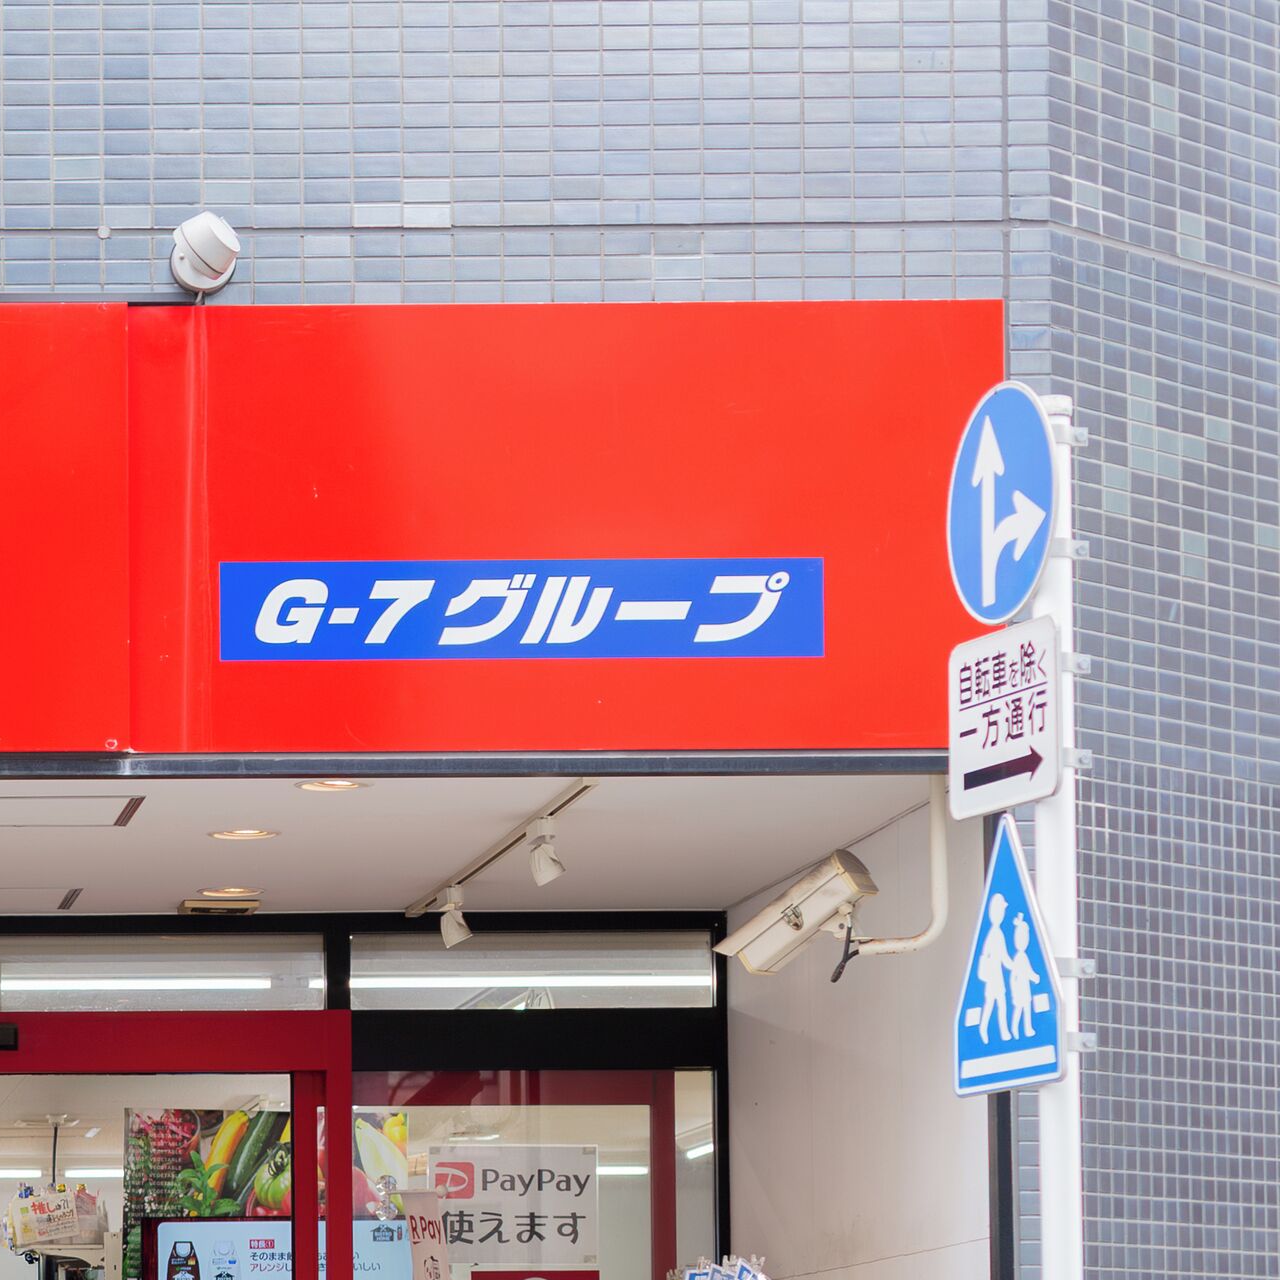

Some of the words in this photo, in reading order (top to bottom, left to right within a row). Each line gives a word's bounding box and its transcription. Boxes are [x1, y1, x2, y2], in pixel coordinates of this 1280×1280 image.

[958, 642, 1048, 704] 自転車を除く
[959, 690, 1048, 752] 一方通行
[481, 1167, 591, 1198] PayPay
[419, 1215, 441, 1245] Pay
[441, 1210, 587, 1245] 使えます
